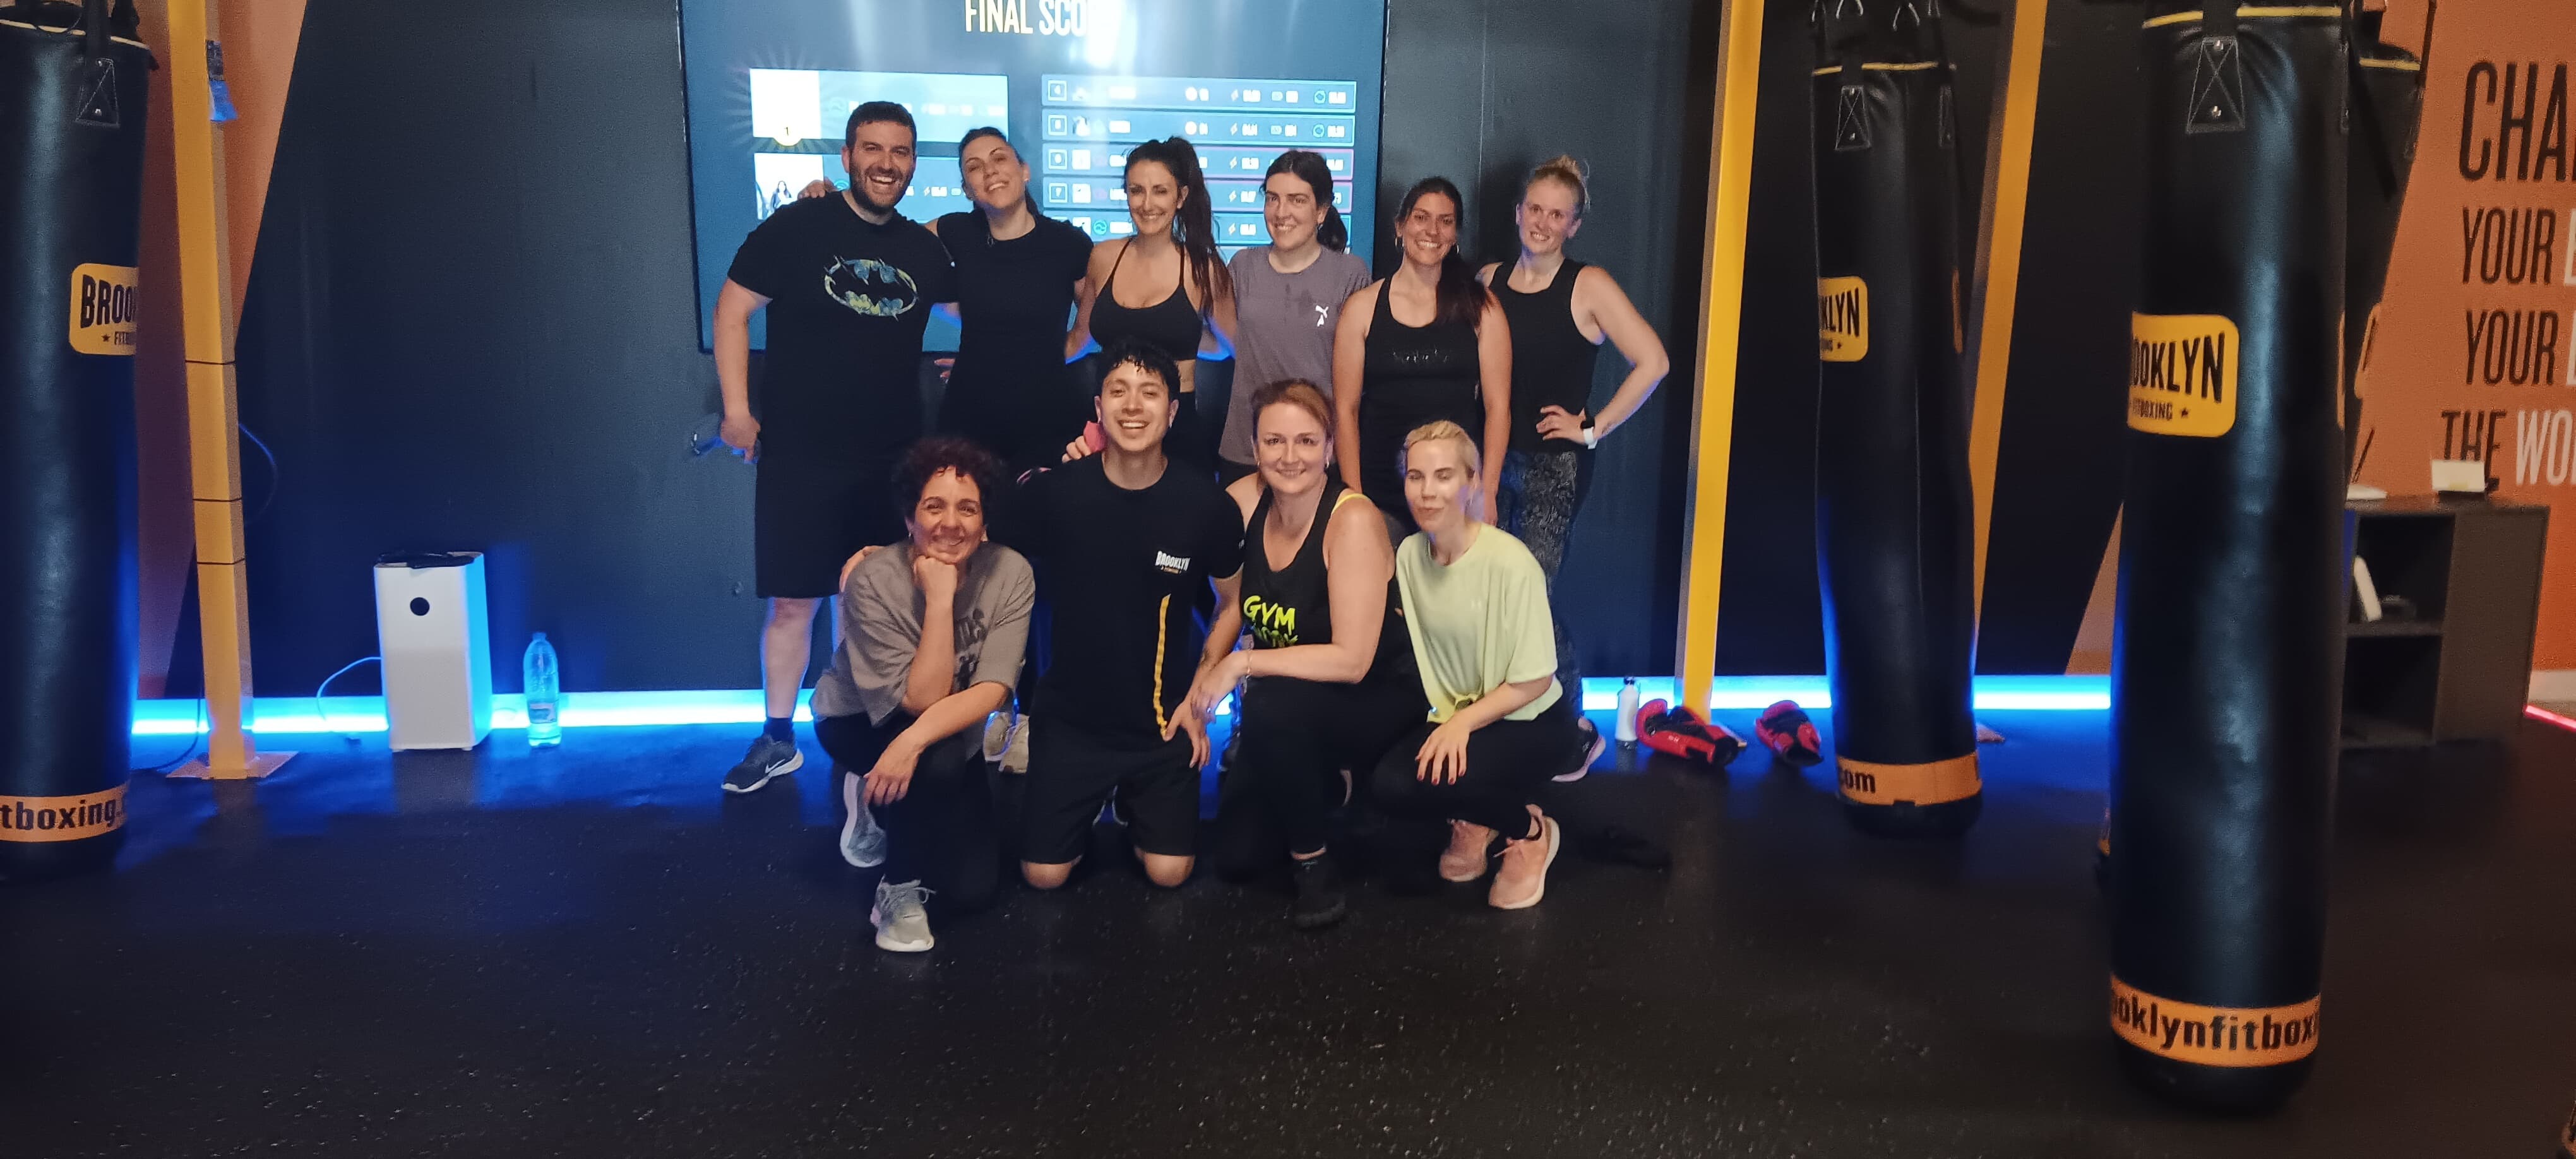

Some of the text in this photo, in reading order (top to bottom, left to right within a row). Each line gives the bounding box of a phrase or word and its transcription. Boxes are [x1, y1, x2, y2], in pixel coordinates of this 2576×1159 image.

[965, 0, 1087, 37] FINAL SCO
[2459, 61, 2576, 181] CHA
[2463, 207, 2556, 284] YOUR
[80, 274, 135, 329] BROO
[2466, 309, 2560, 385] YOUR
[2442, 410, 2576, 486] THE WO
[1243, 595, 1296, 636] GYM
[1840, 769, 1876, 793] om
[2111, 995, 2318, 1050] oklynfitbox
